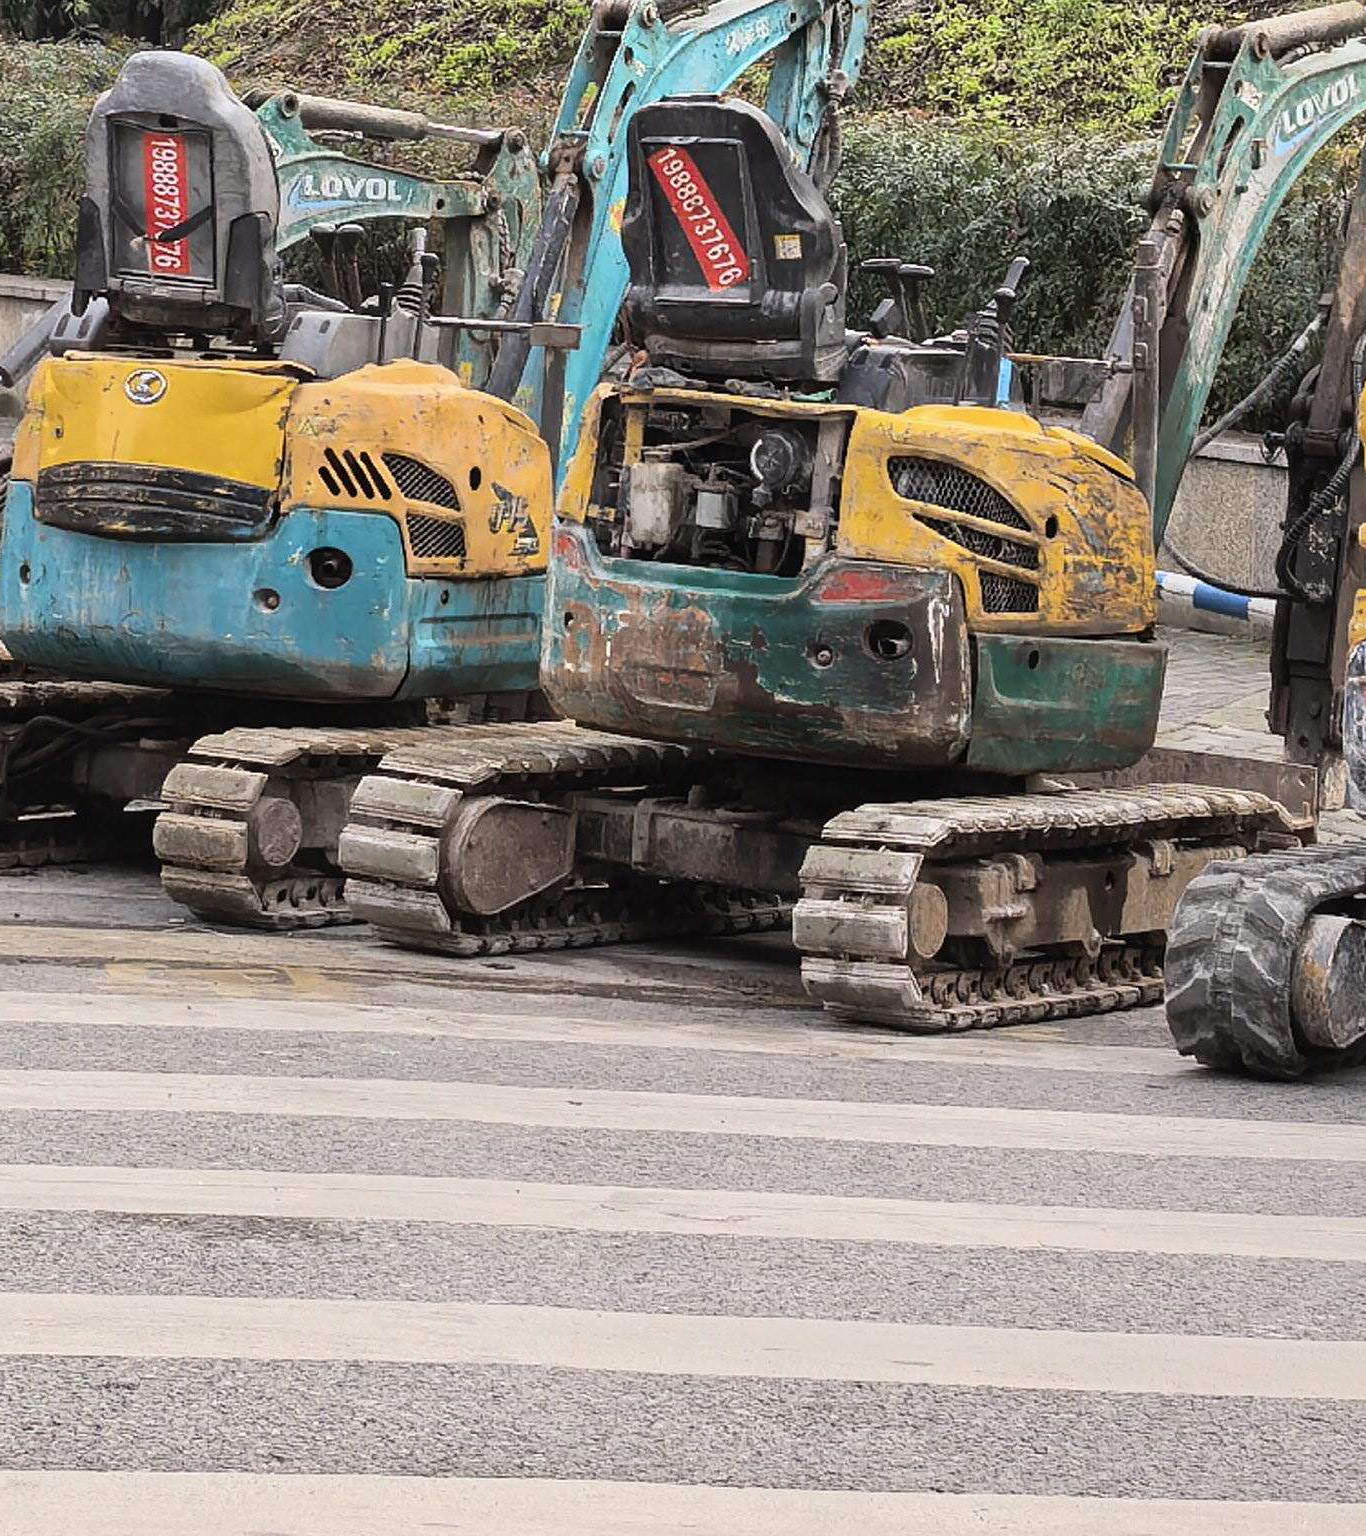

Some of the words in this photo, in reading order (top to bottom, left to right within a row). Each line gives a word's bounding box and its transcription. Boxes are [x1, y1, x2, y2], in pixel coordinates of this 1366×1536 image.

[1281, 72, 1359, 134] LOVOL
[151, 138, 182, 269] 1988873776
[302, 174, 402, 202] LOVOL
[657, 148, 743, 286] 19888737676
